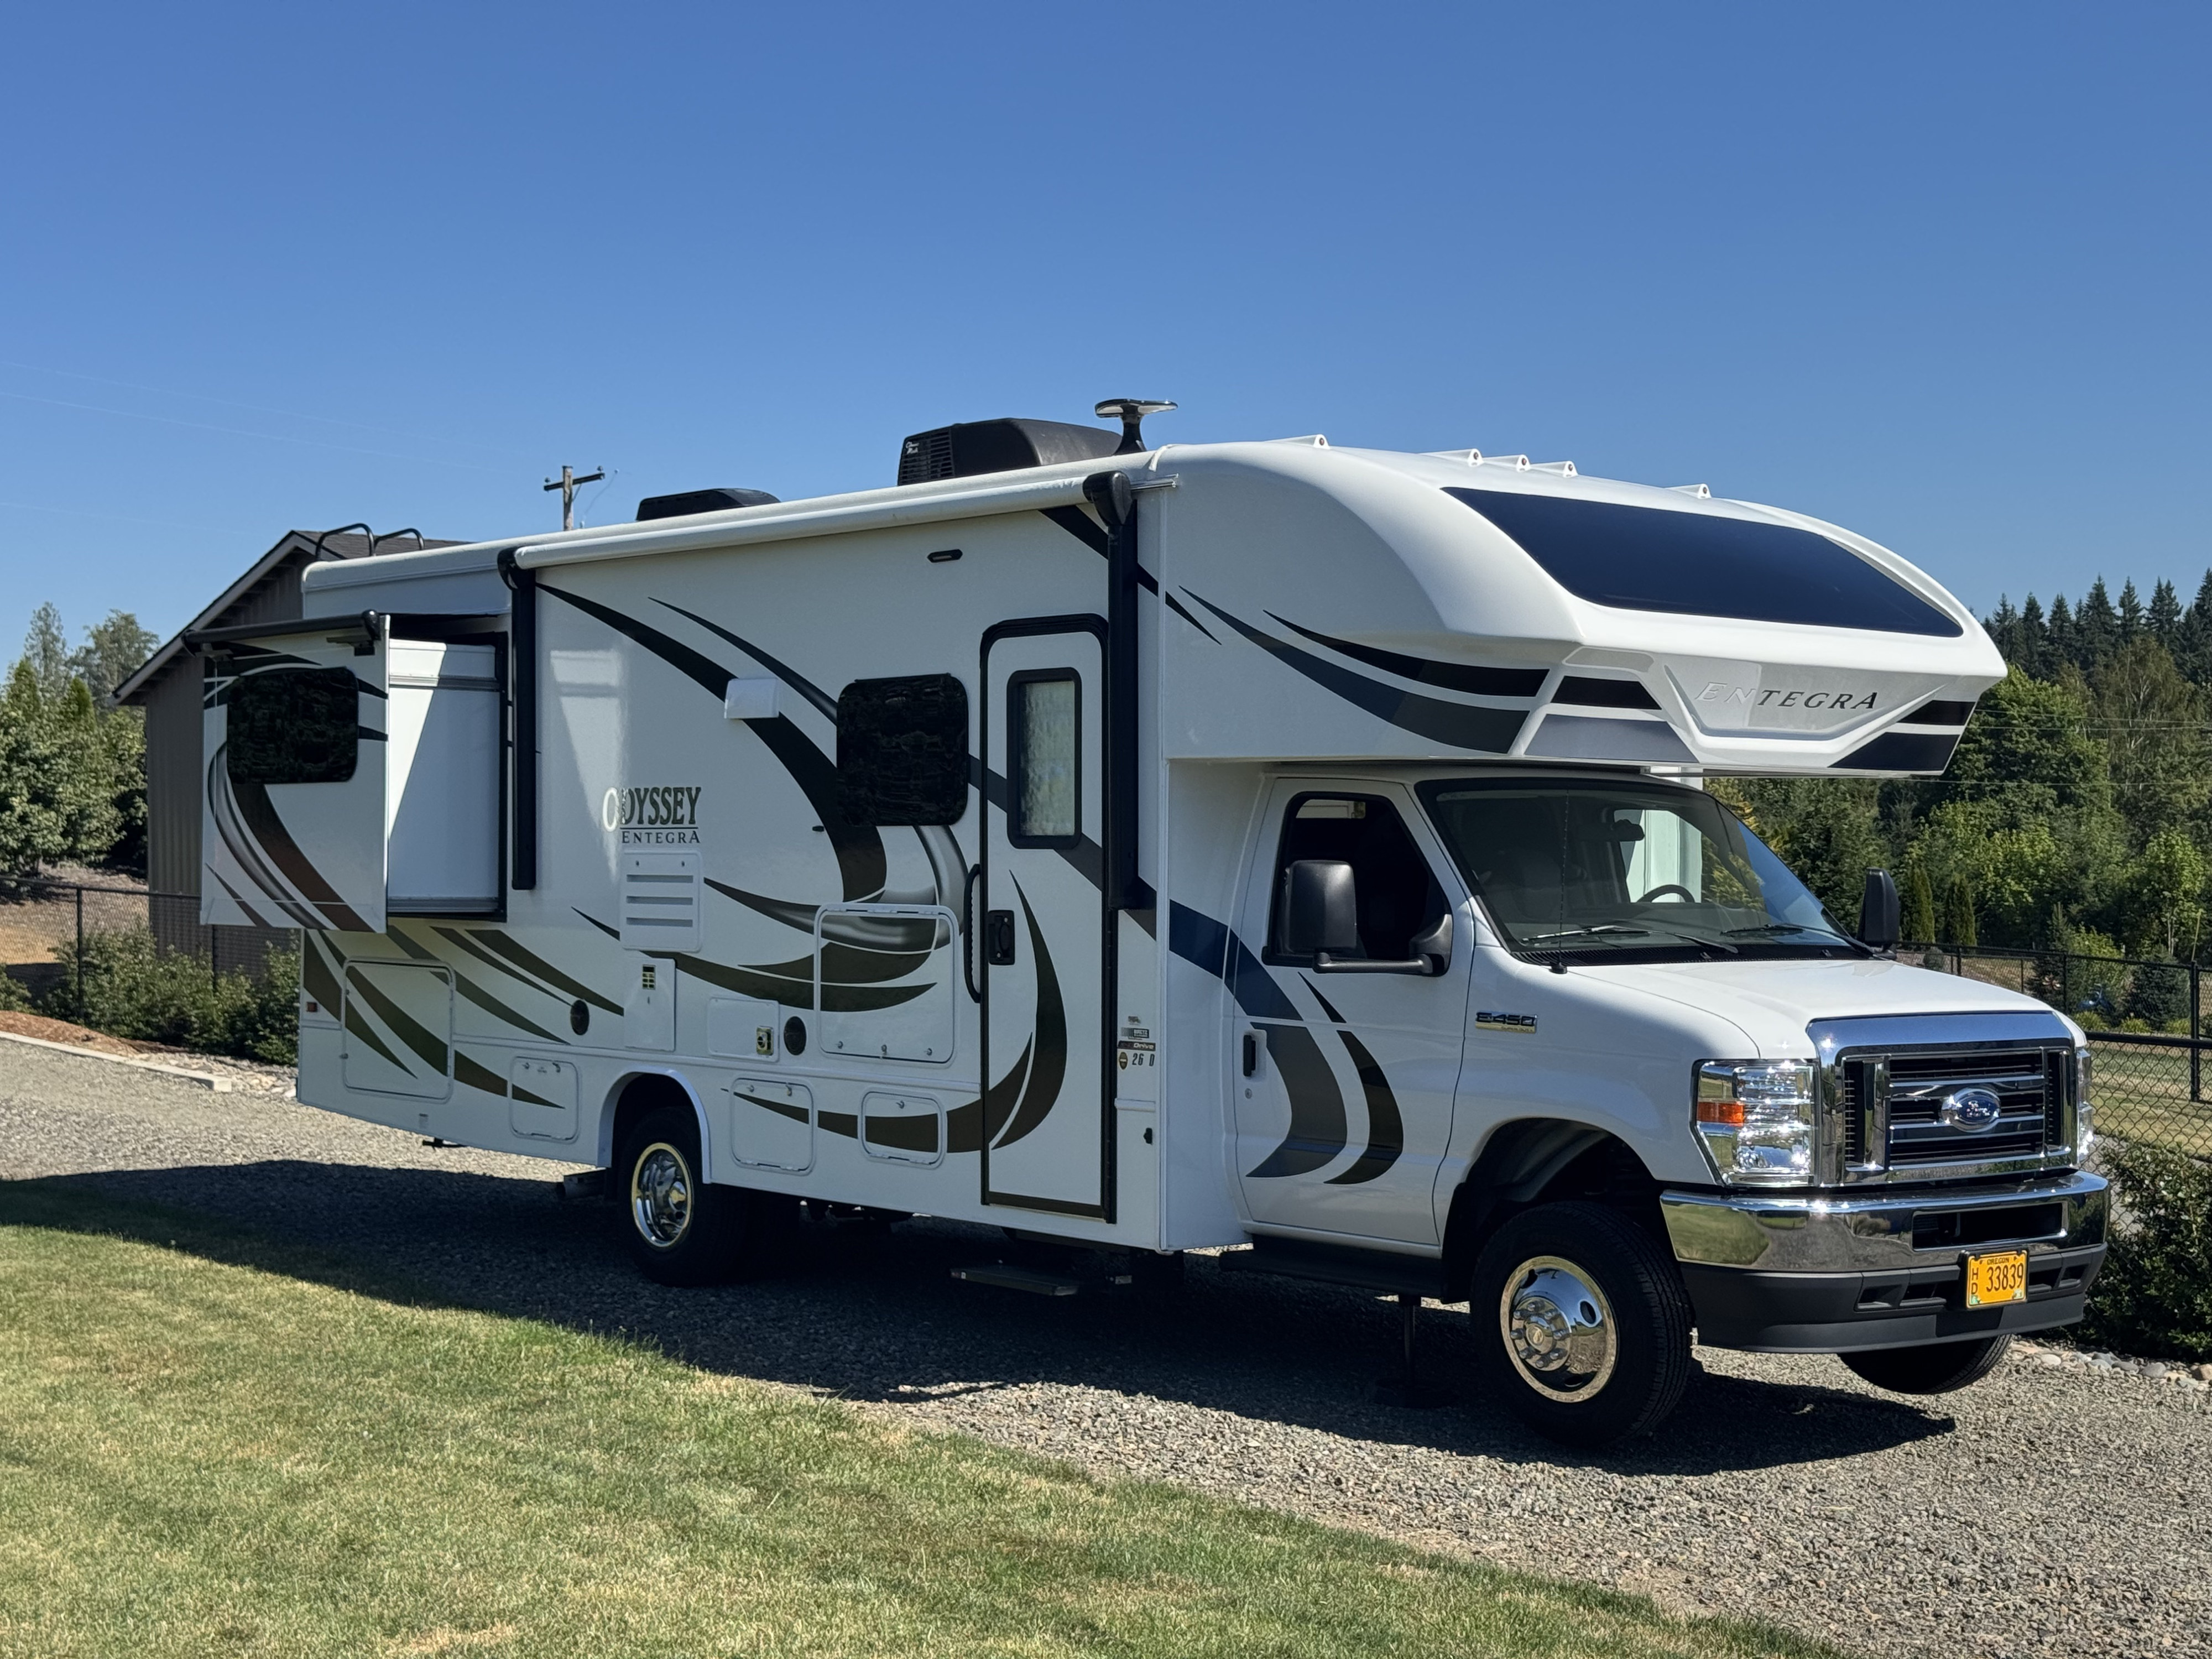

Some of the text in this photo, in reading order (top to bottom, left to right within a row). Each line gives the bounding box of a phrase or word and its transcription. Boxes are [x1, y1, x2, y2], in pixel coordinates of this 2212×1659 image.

[1695, 682, 1878, 709] ENTEGRA
[603, 787, 701, 832] ODYSSEY
[622, 831, 701, 843] ENTEGRA
[1986, 1263, 2024, 1292] 33839
